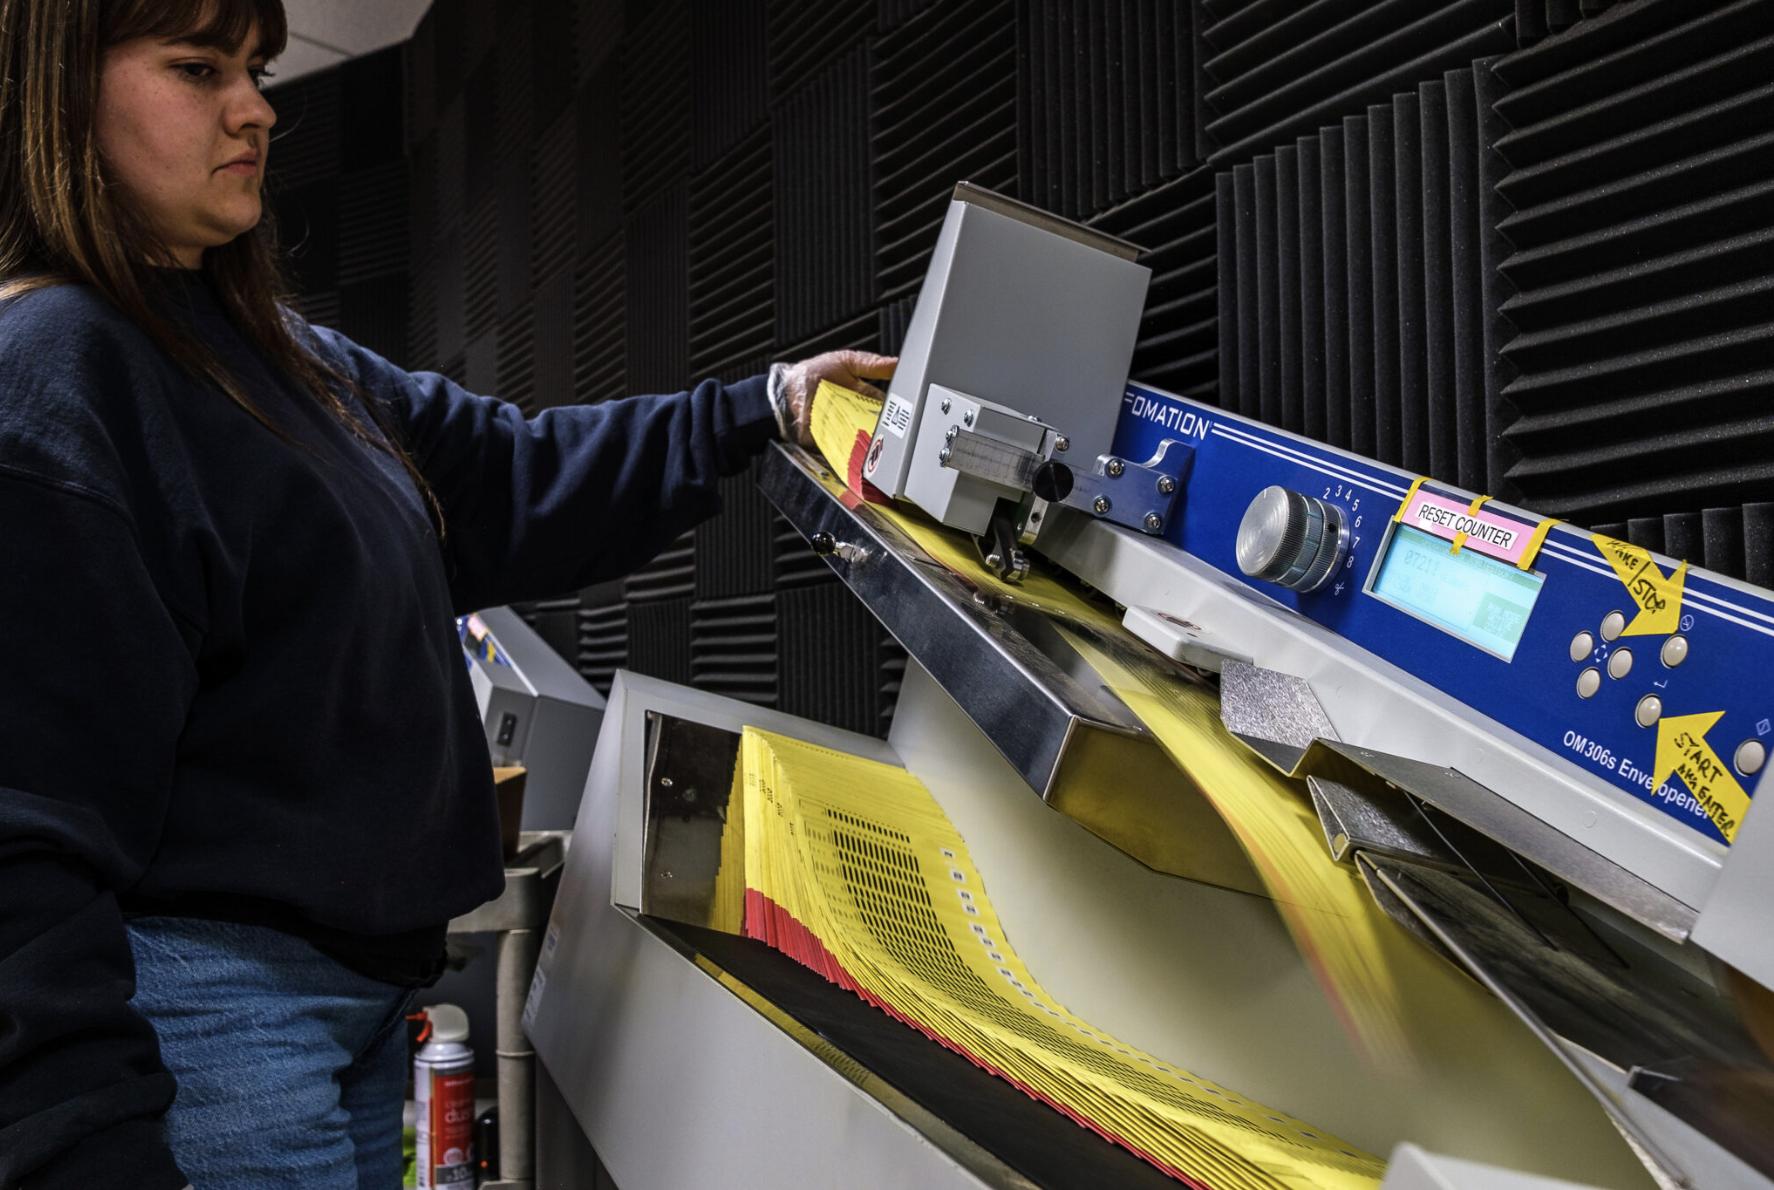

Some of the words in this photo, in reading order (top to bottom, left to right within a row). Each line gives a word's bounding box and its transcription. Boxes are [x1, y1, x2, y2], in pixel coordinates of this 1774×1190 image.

[1131, 396, 1209, 440] OMATION
[1322, 487, 1331, 500] 2
[1335, 484, 1343, 497] 3
[1344, 488, 1352, 501] 4
[1351, 499, 1360, 512] 5
[1354, 515, 1362, 528] 6
[1418, 504, 1455, 527] RESET
[1455, 516, 1513, 548] COUNTER
[1352, 536, 1360, 549] 7
[1346, 556, 1354, 569] 8
[1674, 731, 1724, 783] START
[1563, 730, 1617, 770] OM306s
[1617, 758, 1709, 820] Enveopene
[1698, 785, 1736, 838] ENTER
